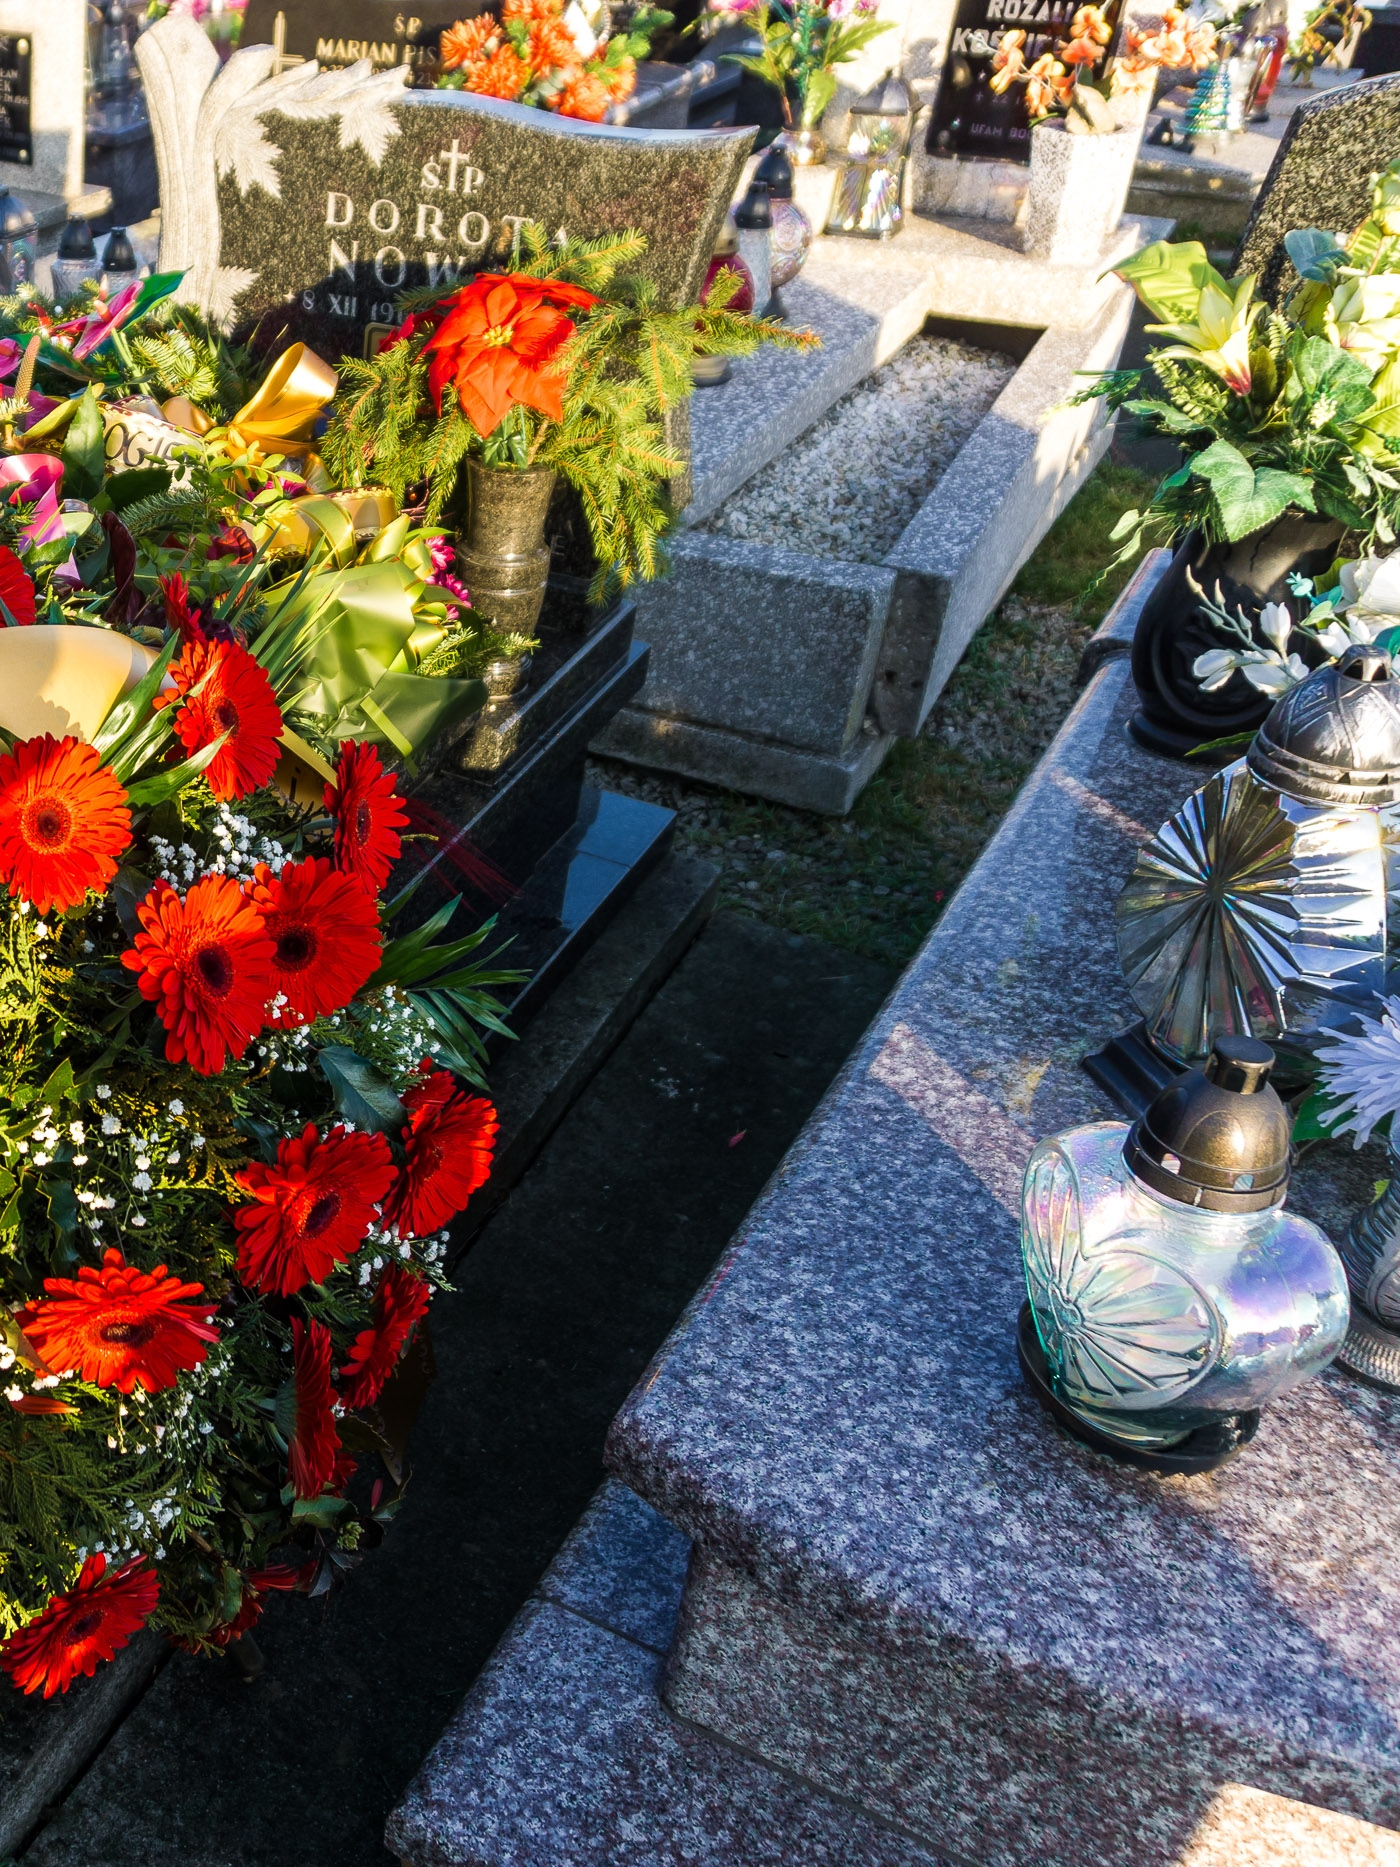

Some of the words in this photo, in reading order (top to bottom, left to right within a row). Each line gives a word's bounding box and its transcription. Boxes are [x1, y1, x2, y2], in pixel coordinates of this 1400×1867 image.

[987, 0, 1084, 22] ROZALI
[315, 37, 396, 63] MARIAN
[325, 191, 569, 250] DOROTA
[327, 238, 468, 290] NOW
[302, 289, 316, 311] 8
[329, 292, 357, 318] XII
